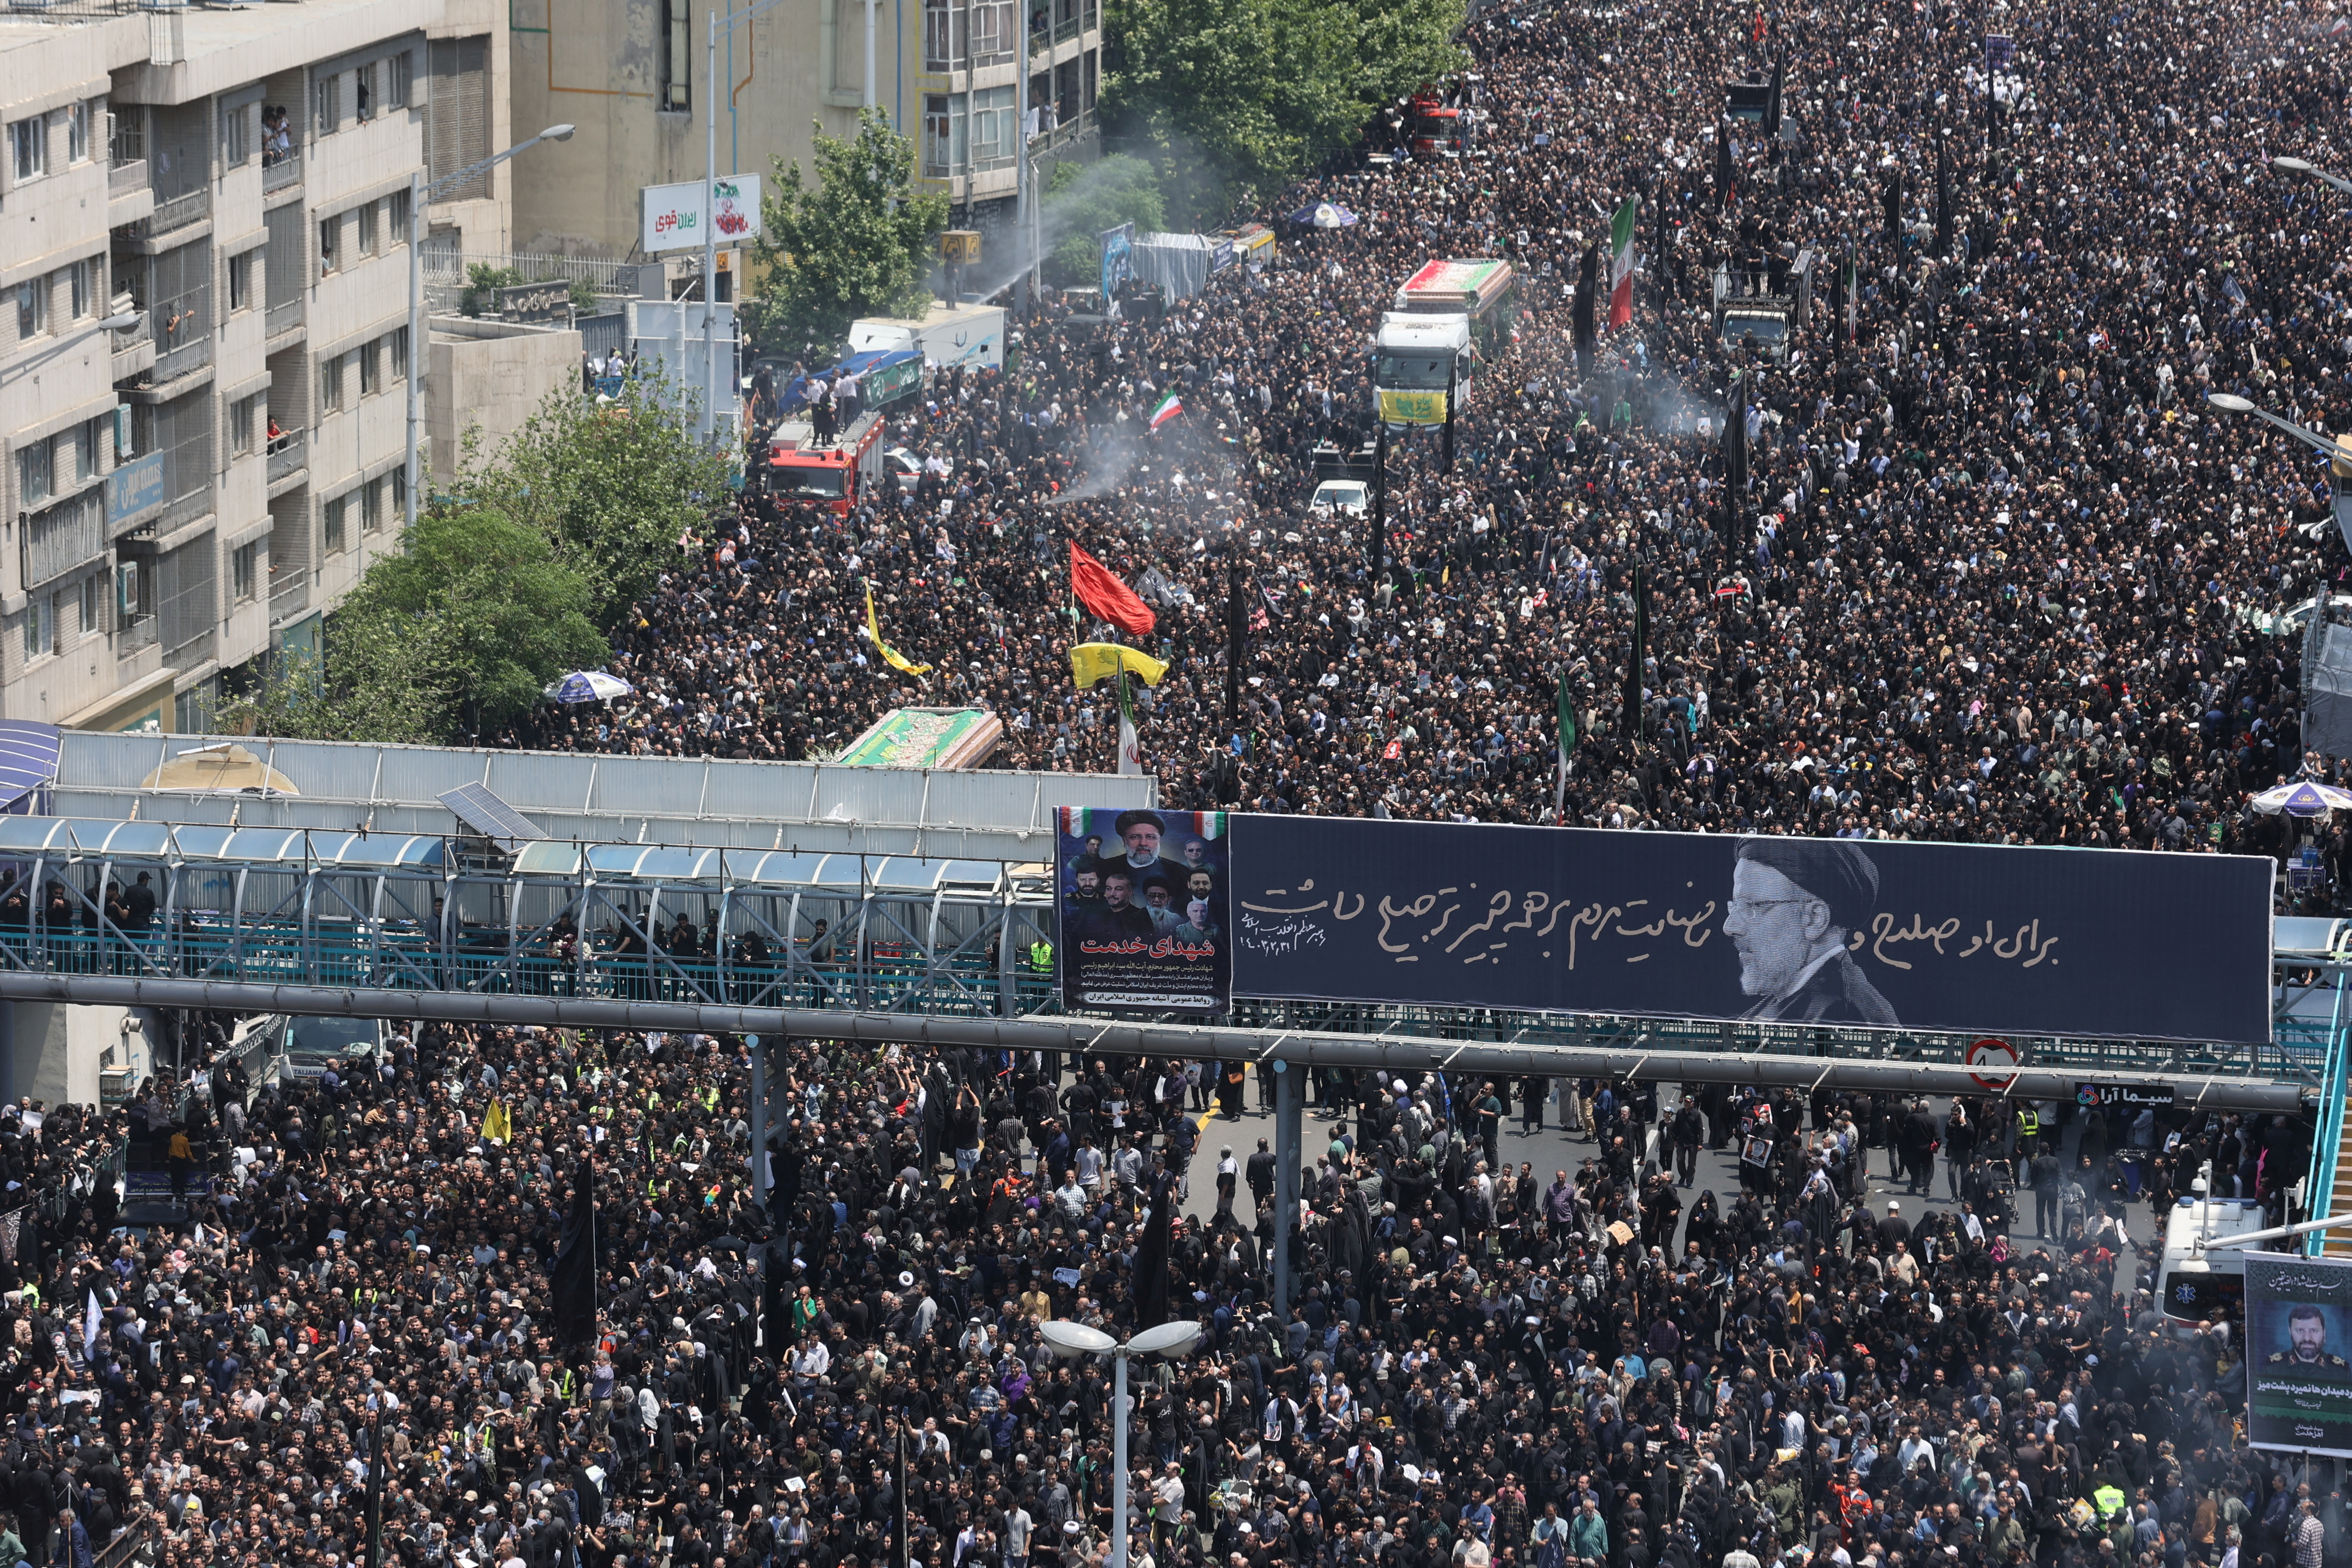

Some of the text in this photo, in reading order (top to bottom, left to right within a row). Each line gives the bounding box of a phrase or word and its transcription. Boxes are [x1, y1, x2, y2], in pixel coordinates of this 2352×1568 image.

[1848, 931, 1865, 951] و
[1959, 920, 1993, 958] او
[1993, 918, 2059, 968] برای
[1080, 935, 1215, 961] شهدای خدمت
[1080, 961, 1097, 970] رئیسی
[1097, 962, 1115, 971] ابراهیم
[1135, 962, 1146, 971] آیت
[1088, 993, 1104, 1001] ایران
[1151, 995, 1171, 1003] آشیانه
[1192, 996, 1210, 1005] روابط
[2100, 1087, 2173, 1106] سیما آرا
[2257, 1380, 2270, 1391] میز
[2270, 1380, 2290, 1395] پشت
[2311, 1384, 2321, 1394] ها
